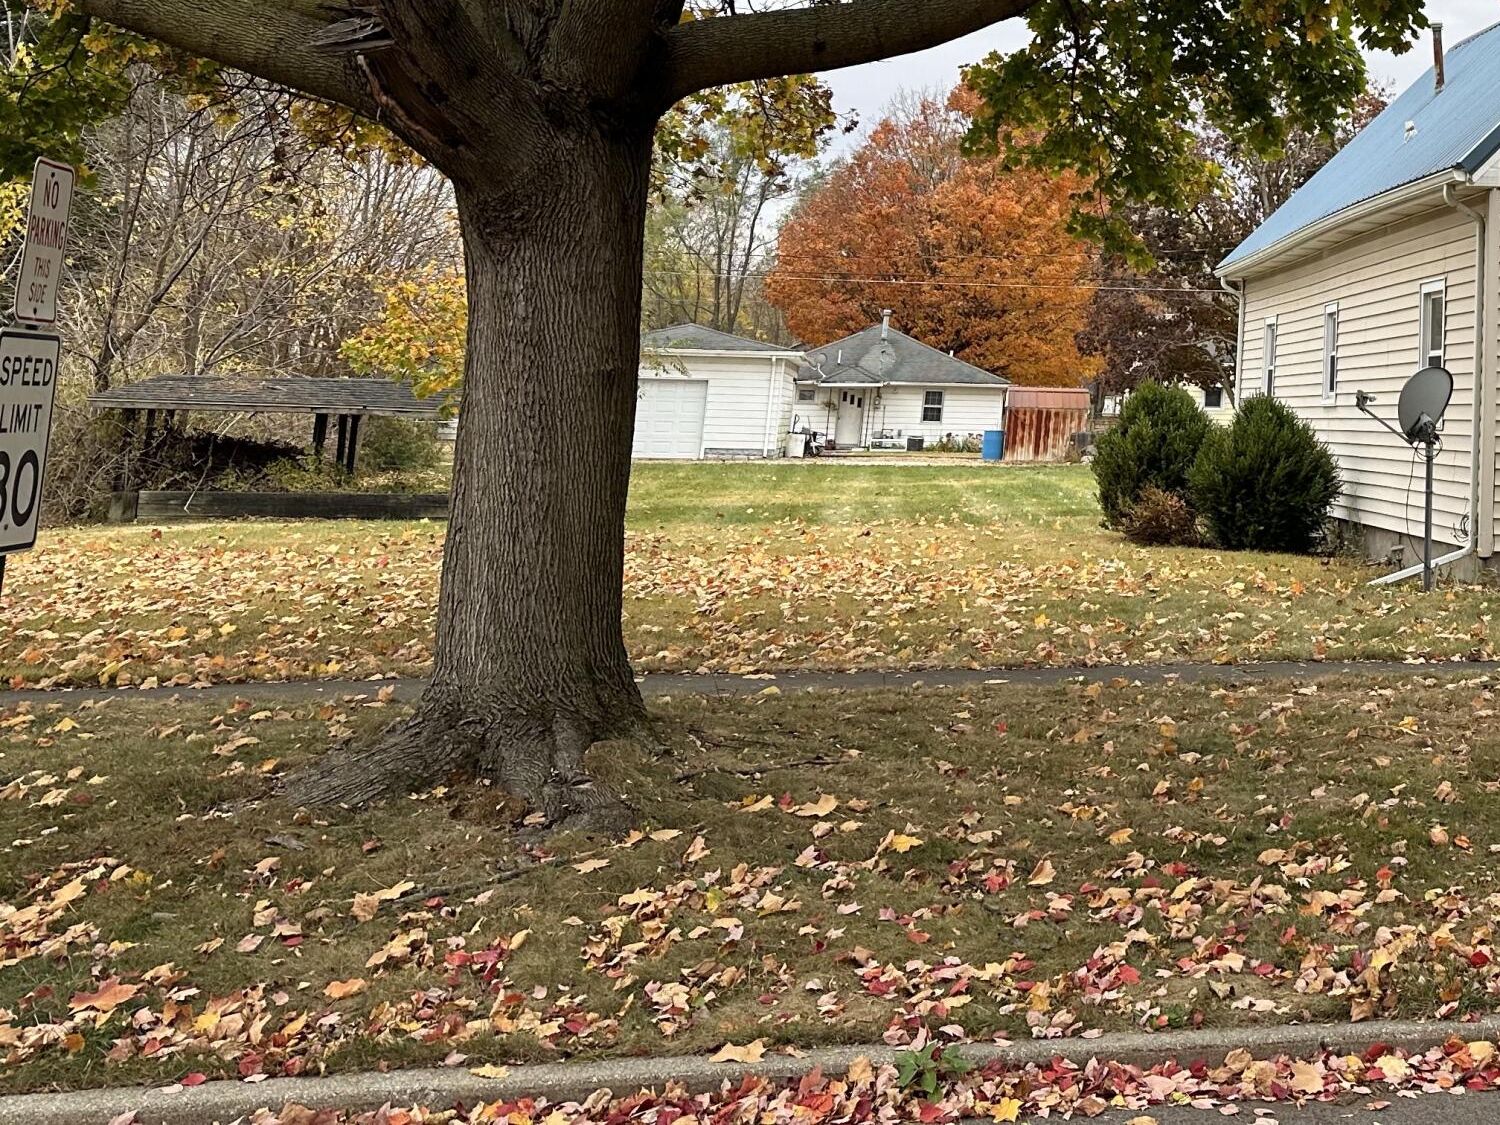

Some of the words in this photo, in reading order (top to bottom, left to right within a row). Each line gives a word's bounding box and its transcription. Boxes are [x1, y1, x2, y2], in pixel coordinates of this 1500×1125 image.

[43, 179, 60, 209] NO
[29, 215, 65, 250] PARKING
[34, 257, 51, 279] THIS
[28, 282, 47, 304] SIDE
[0, 356, 53, 387] SPEED
[0, 404, 42, 434] LIMIT
